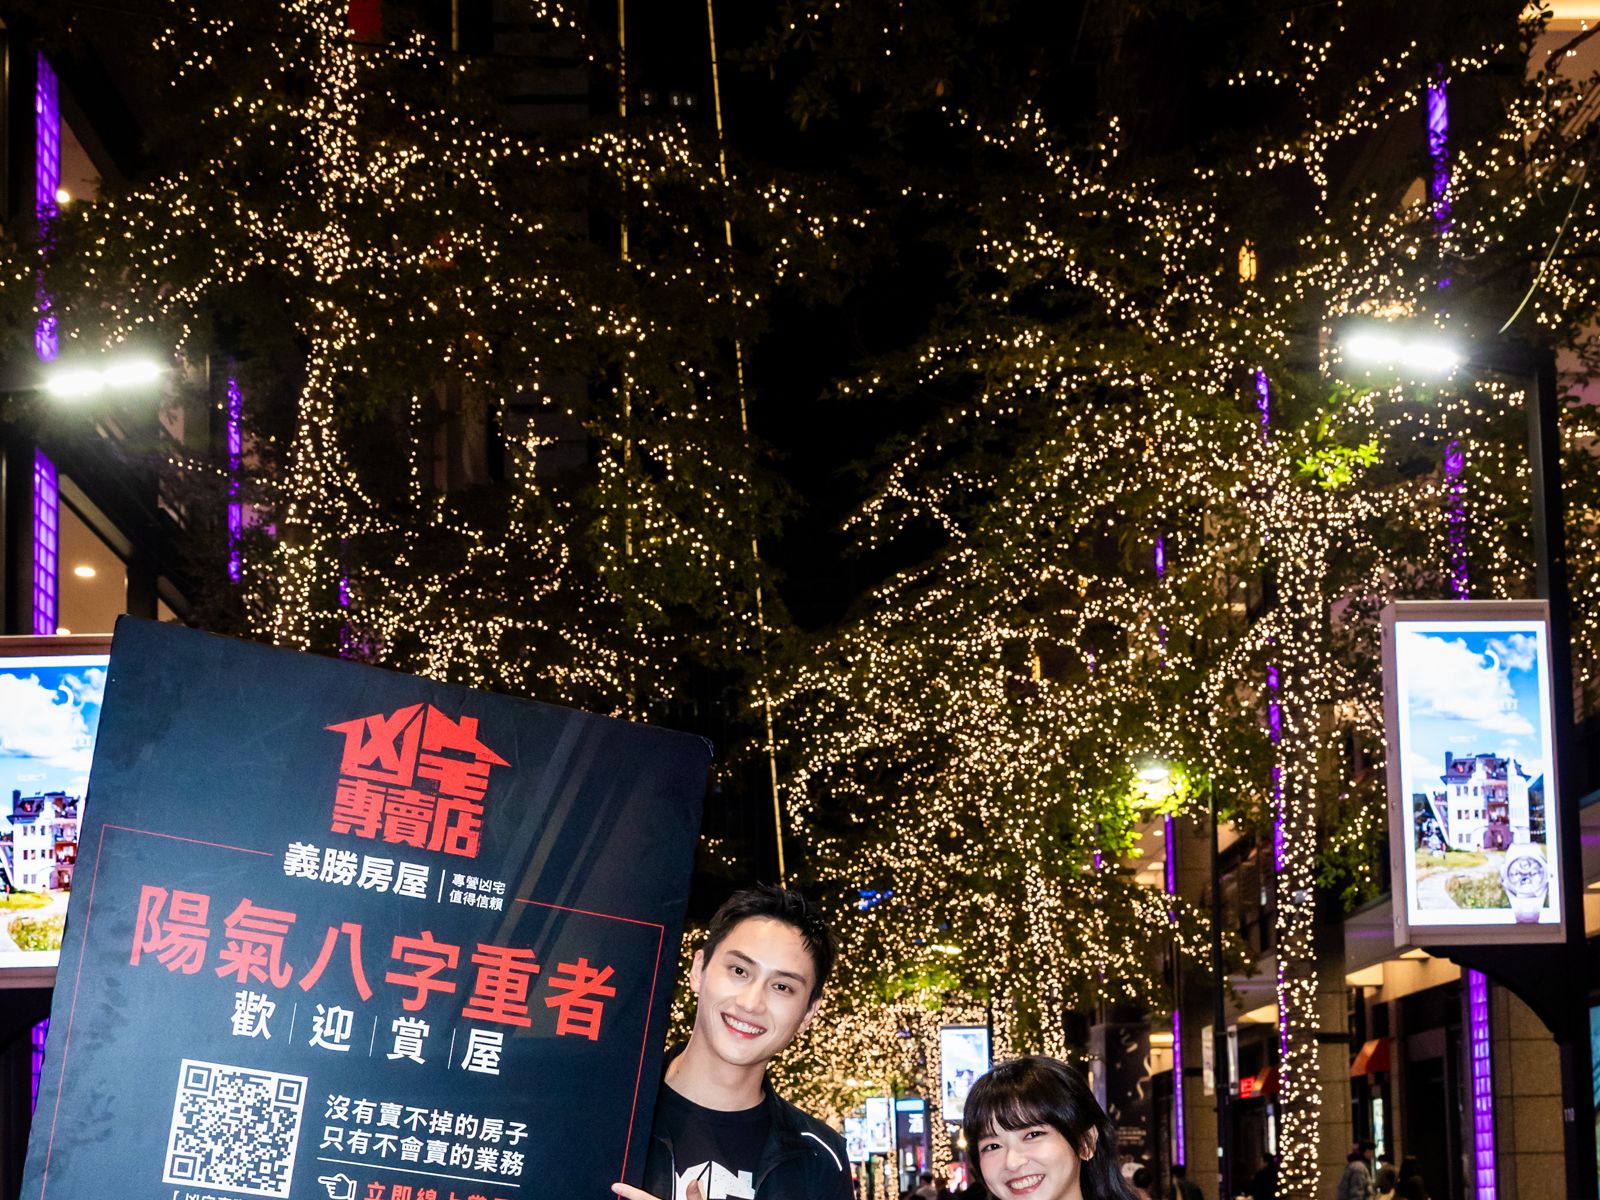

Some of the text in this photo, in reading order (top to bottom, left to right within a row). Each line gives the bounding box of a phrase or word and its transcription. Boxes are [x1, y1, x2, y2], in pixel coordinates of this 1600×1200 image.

[323, 703, 512, 800] 凶宅
[331, 778, 484, 858] 專賣店
[284, 842, 429, 898] 義勝房屋
[452, 873, 506, 894] 專營凶宅
[449, 889, 503, 911] 值得信賴
[129, 885, 616, 1041] 陽氣八字重者
[325, 1094, 528, 1145] 沒有賣不掉的房子
[319, 1126, 525, 1177] 只有不會賣的業務
